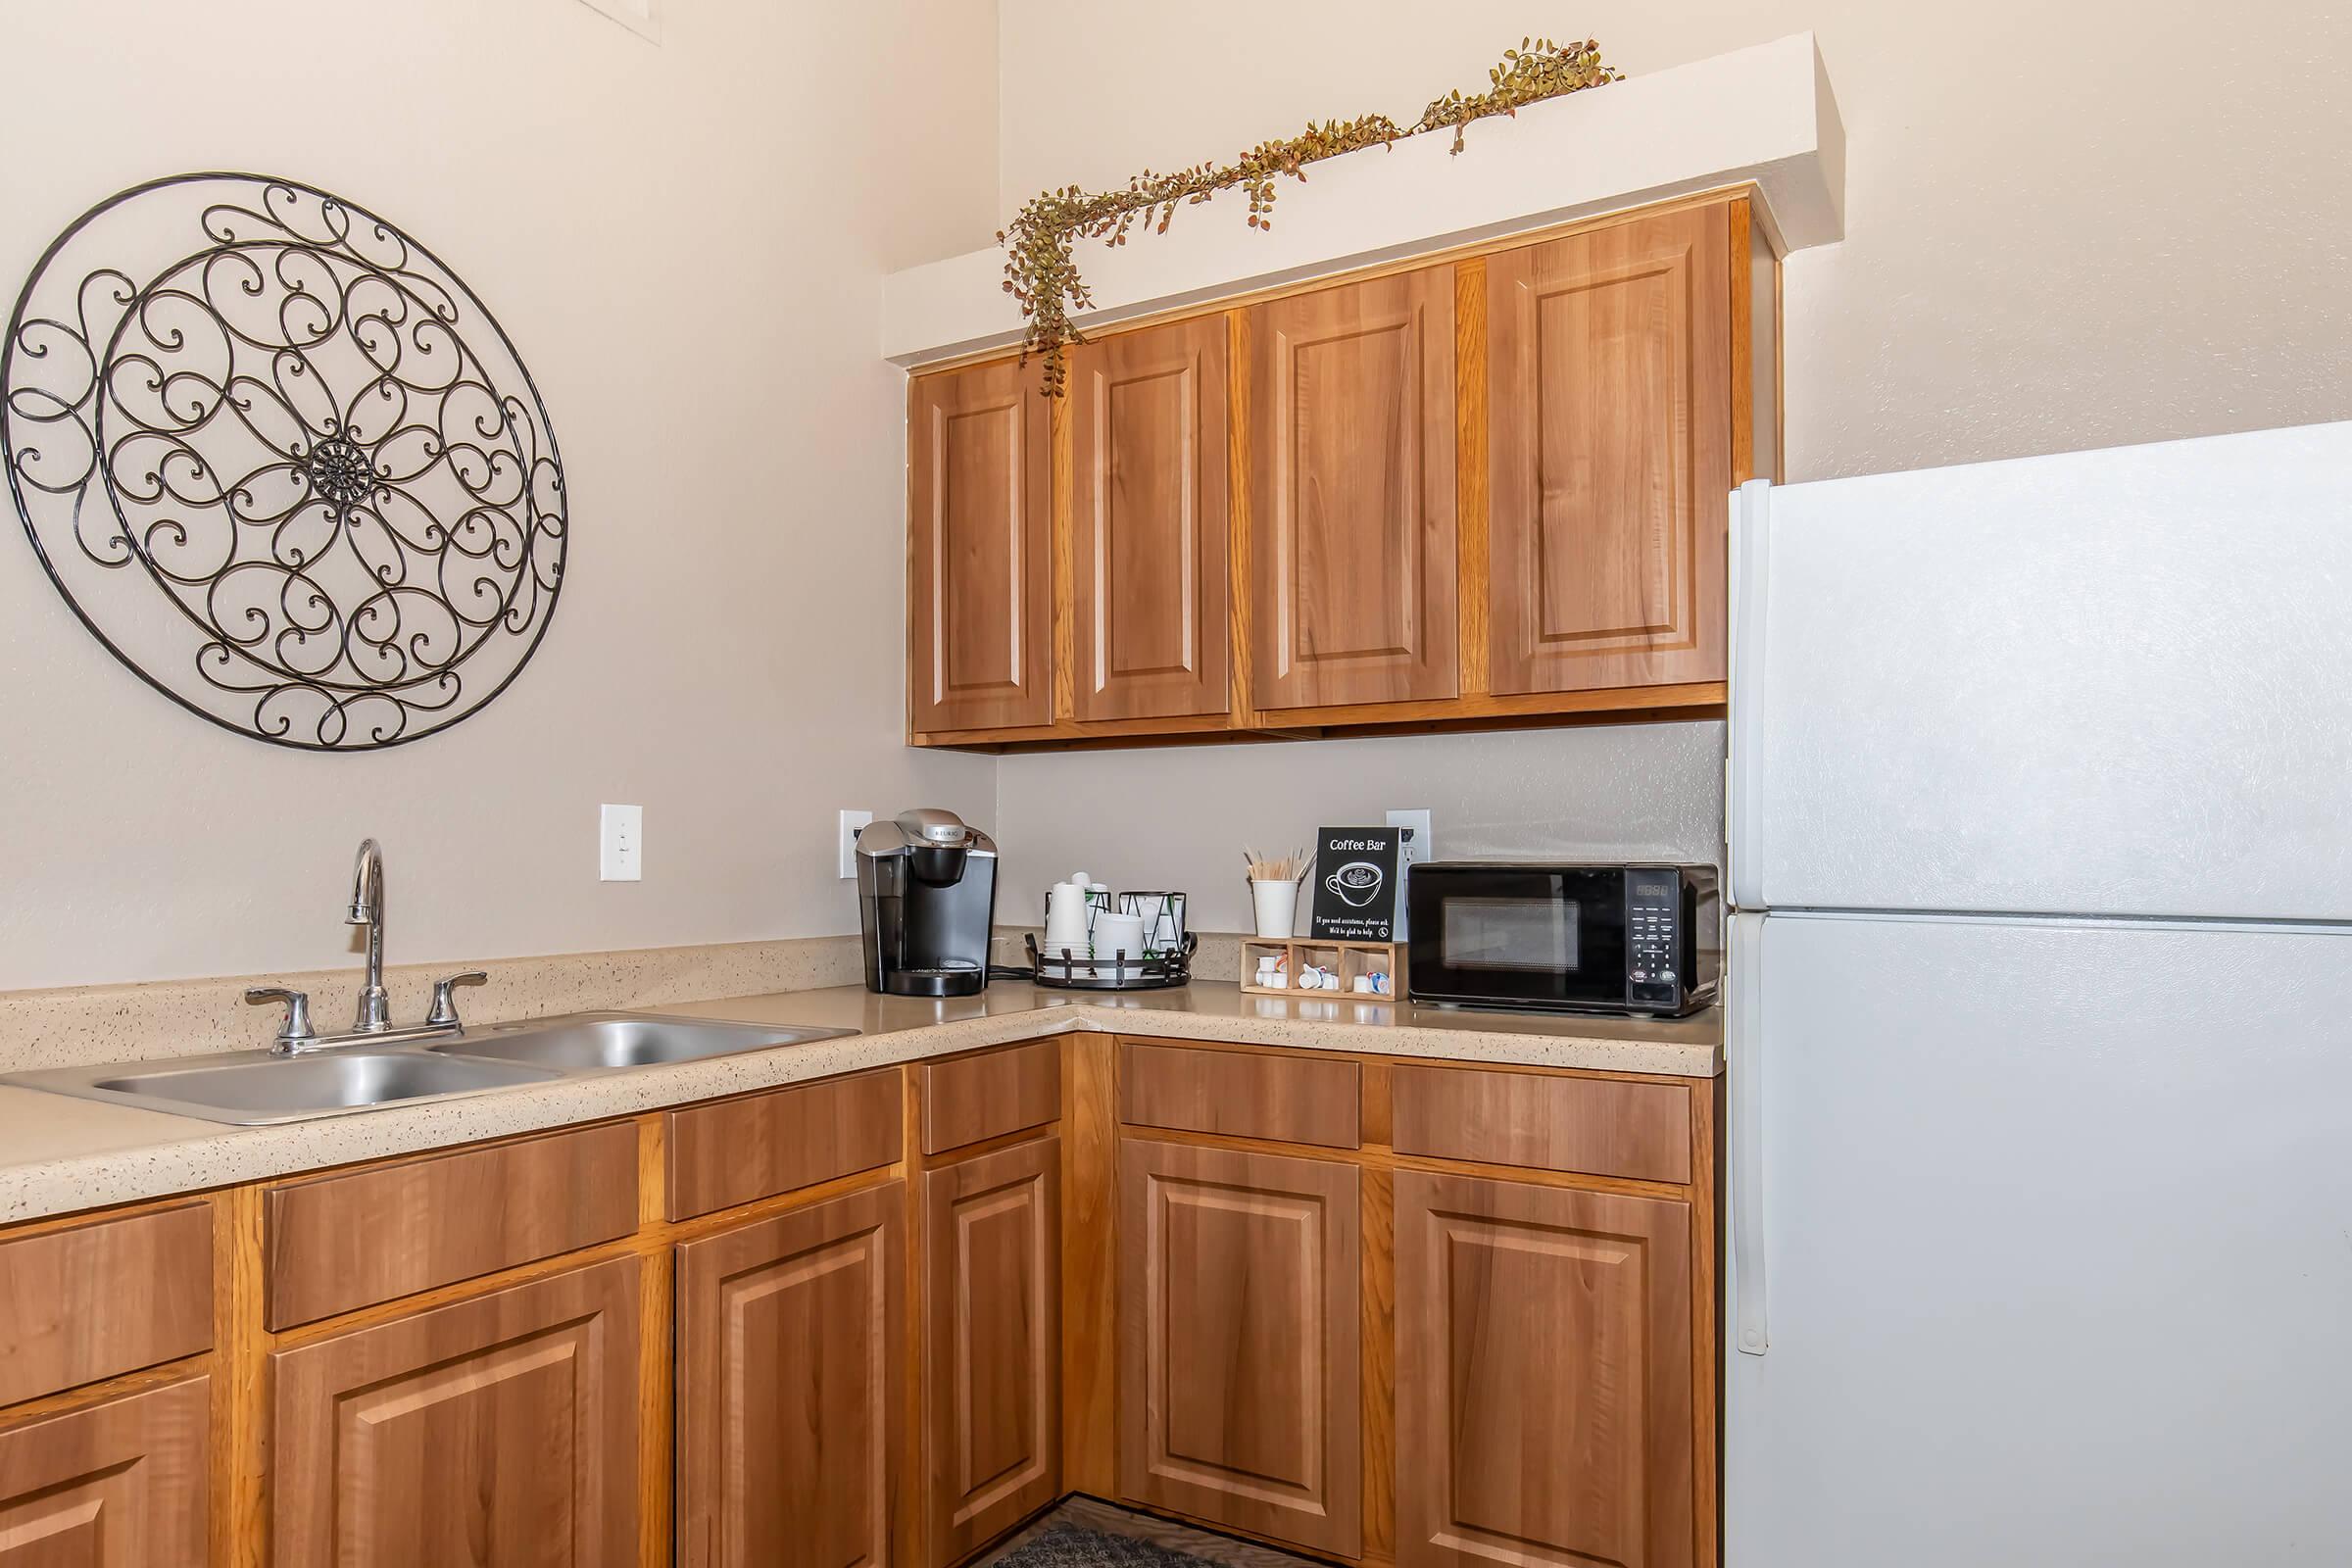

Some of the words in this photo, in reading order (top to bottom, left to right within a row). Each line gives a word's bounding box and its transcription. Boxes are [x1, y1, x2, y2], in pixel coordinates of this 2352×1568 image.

[1330, 839, 1365, 851] Coffee
[1366, 839, 1387, 851] Bar
[1365, 917, 1379, 927] please
[1347, 927, 1356, 937] glad
